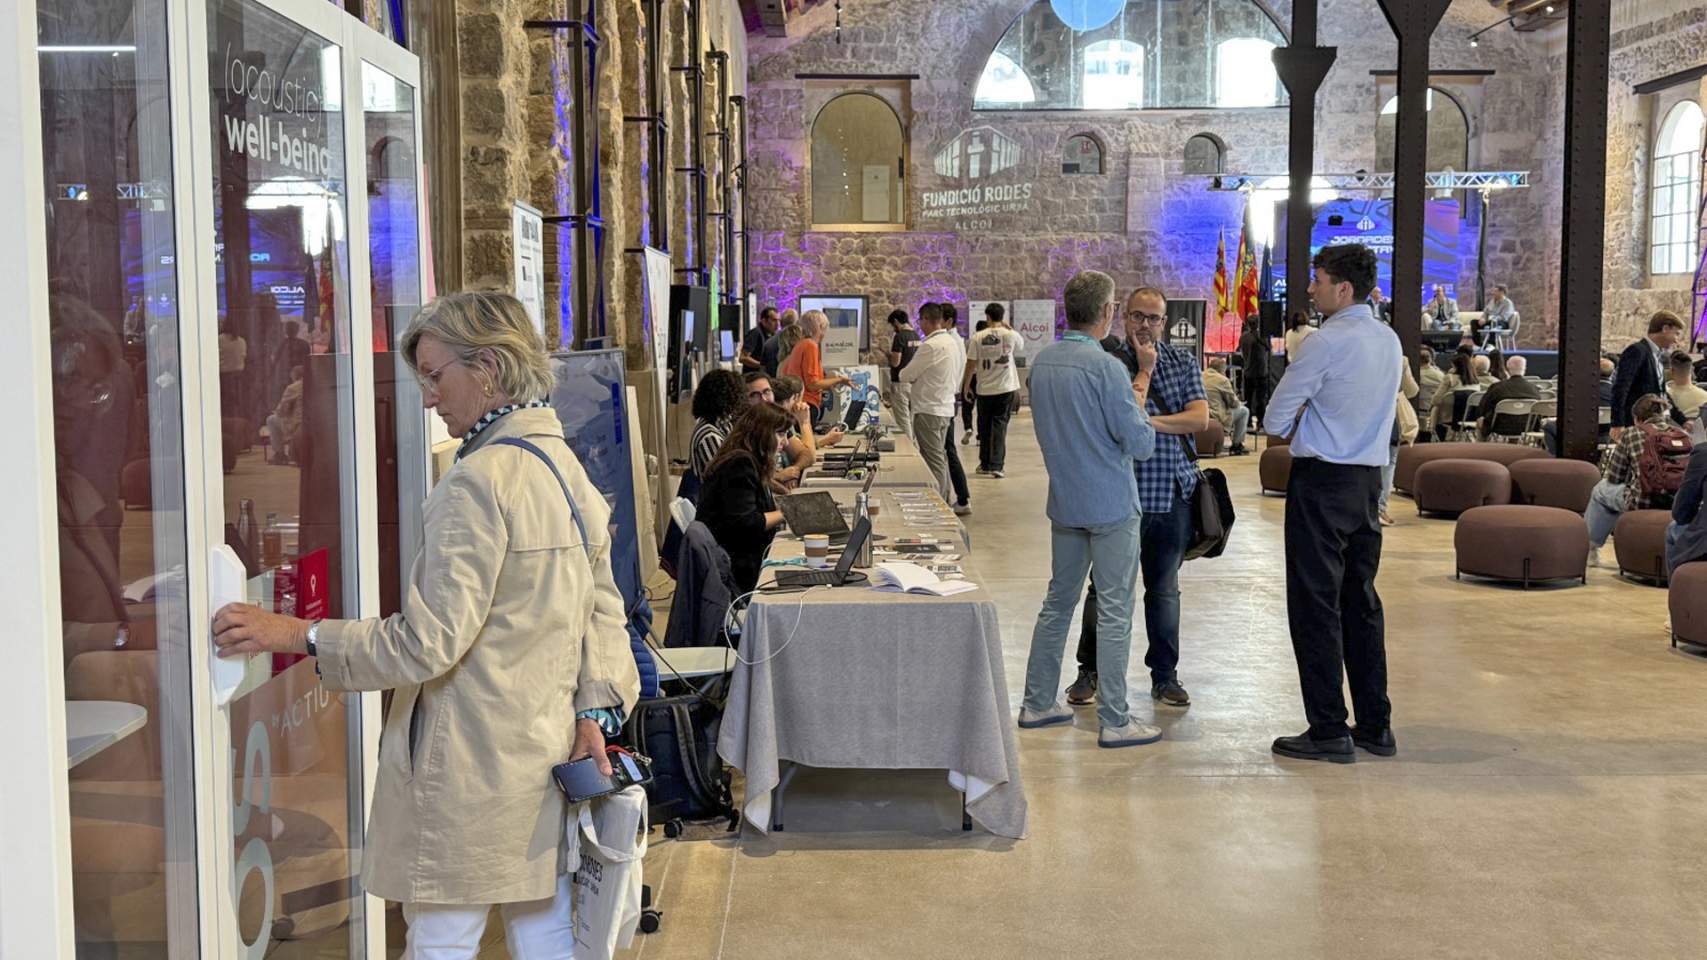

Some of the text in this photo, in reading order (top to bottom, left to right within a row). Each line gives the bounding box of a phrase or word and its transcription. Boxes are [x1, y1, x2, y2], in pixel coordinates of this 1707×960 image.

[922, 183, 1032, 208] FUNDICIÓ RODES
[922, 209, 945, 218] PARC
[955, 220, 993, 231] ALCOI
[1020, 322, 1049, 332] Alcoi
